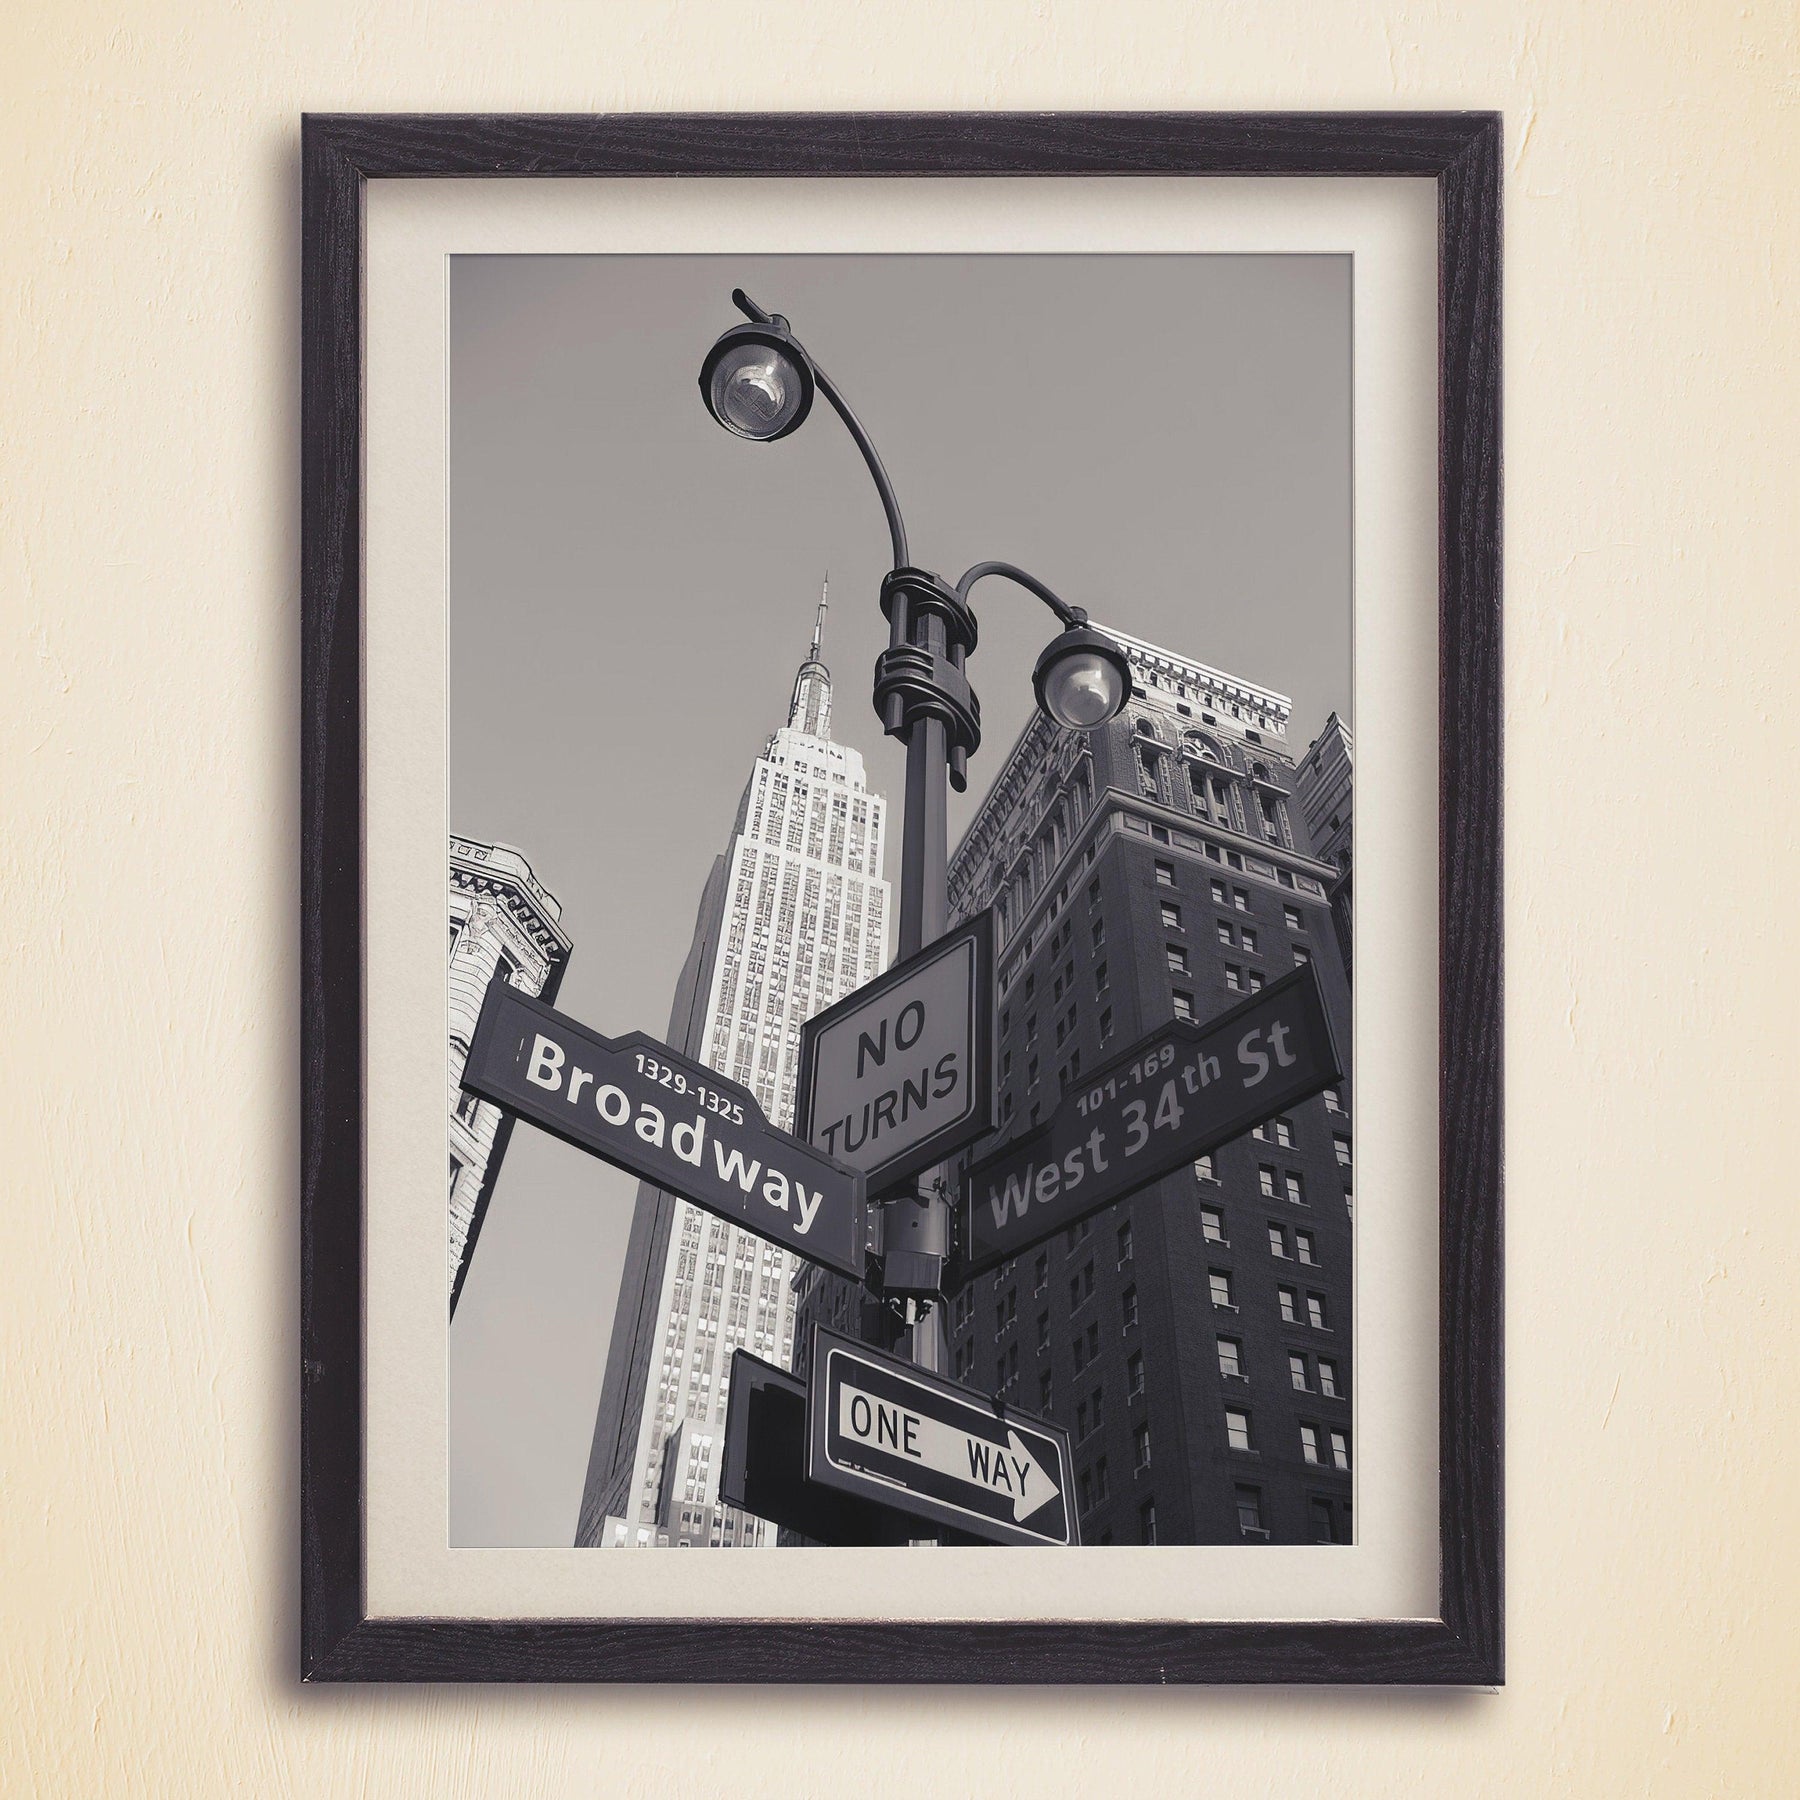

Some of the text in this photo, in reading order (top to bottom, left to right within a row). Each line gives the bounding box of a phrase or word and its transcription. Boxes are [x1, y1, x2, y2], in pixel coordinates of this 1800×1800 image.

[634, 1053, 745, 1126] 1329-1325
[856, 1000, 926, 1079] NO
[1076, 1044, 1175, 1118] 101-169
[525, 1033, 824, 1235] Broadway
[821, 1052, 958, 1156] TURNS
[988, 1019, 1298, 1230] West 34th St
[850, 1394, 922, 1458] ONE
[966, 1438, 1031, 1497] WAY
